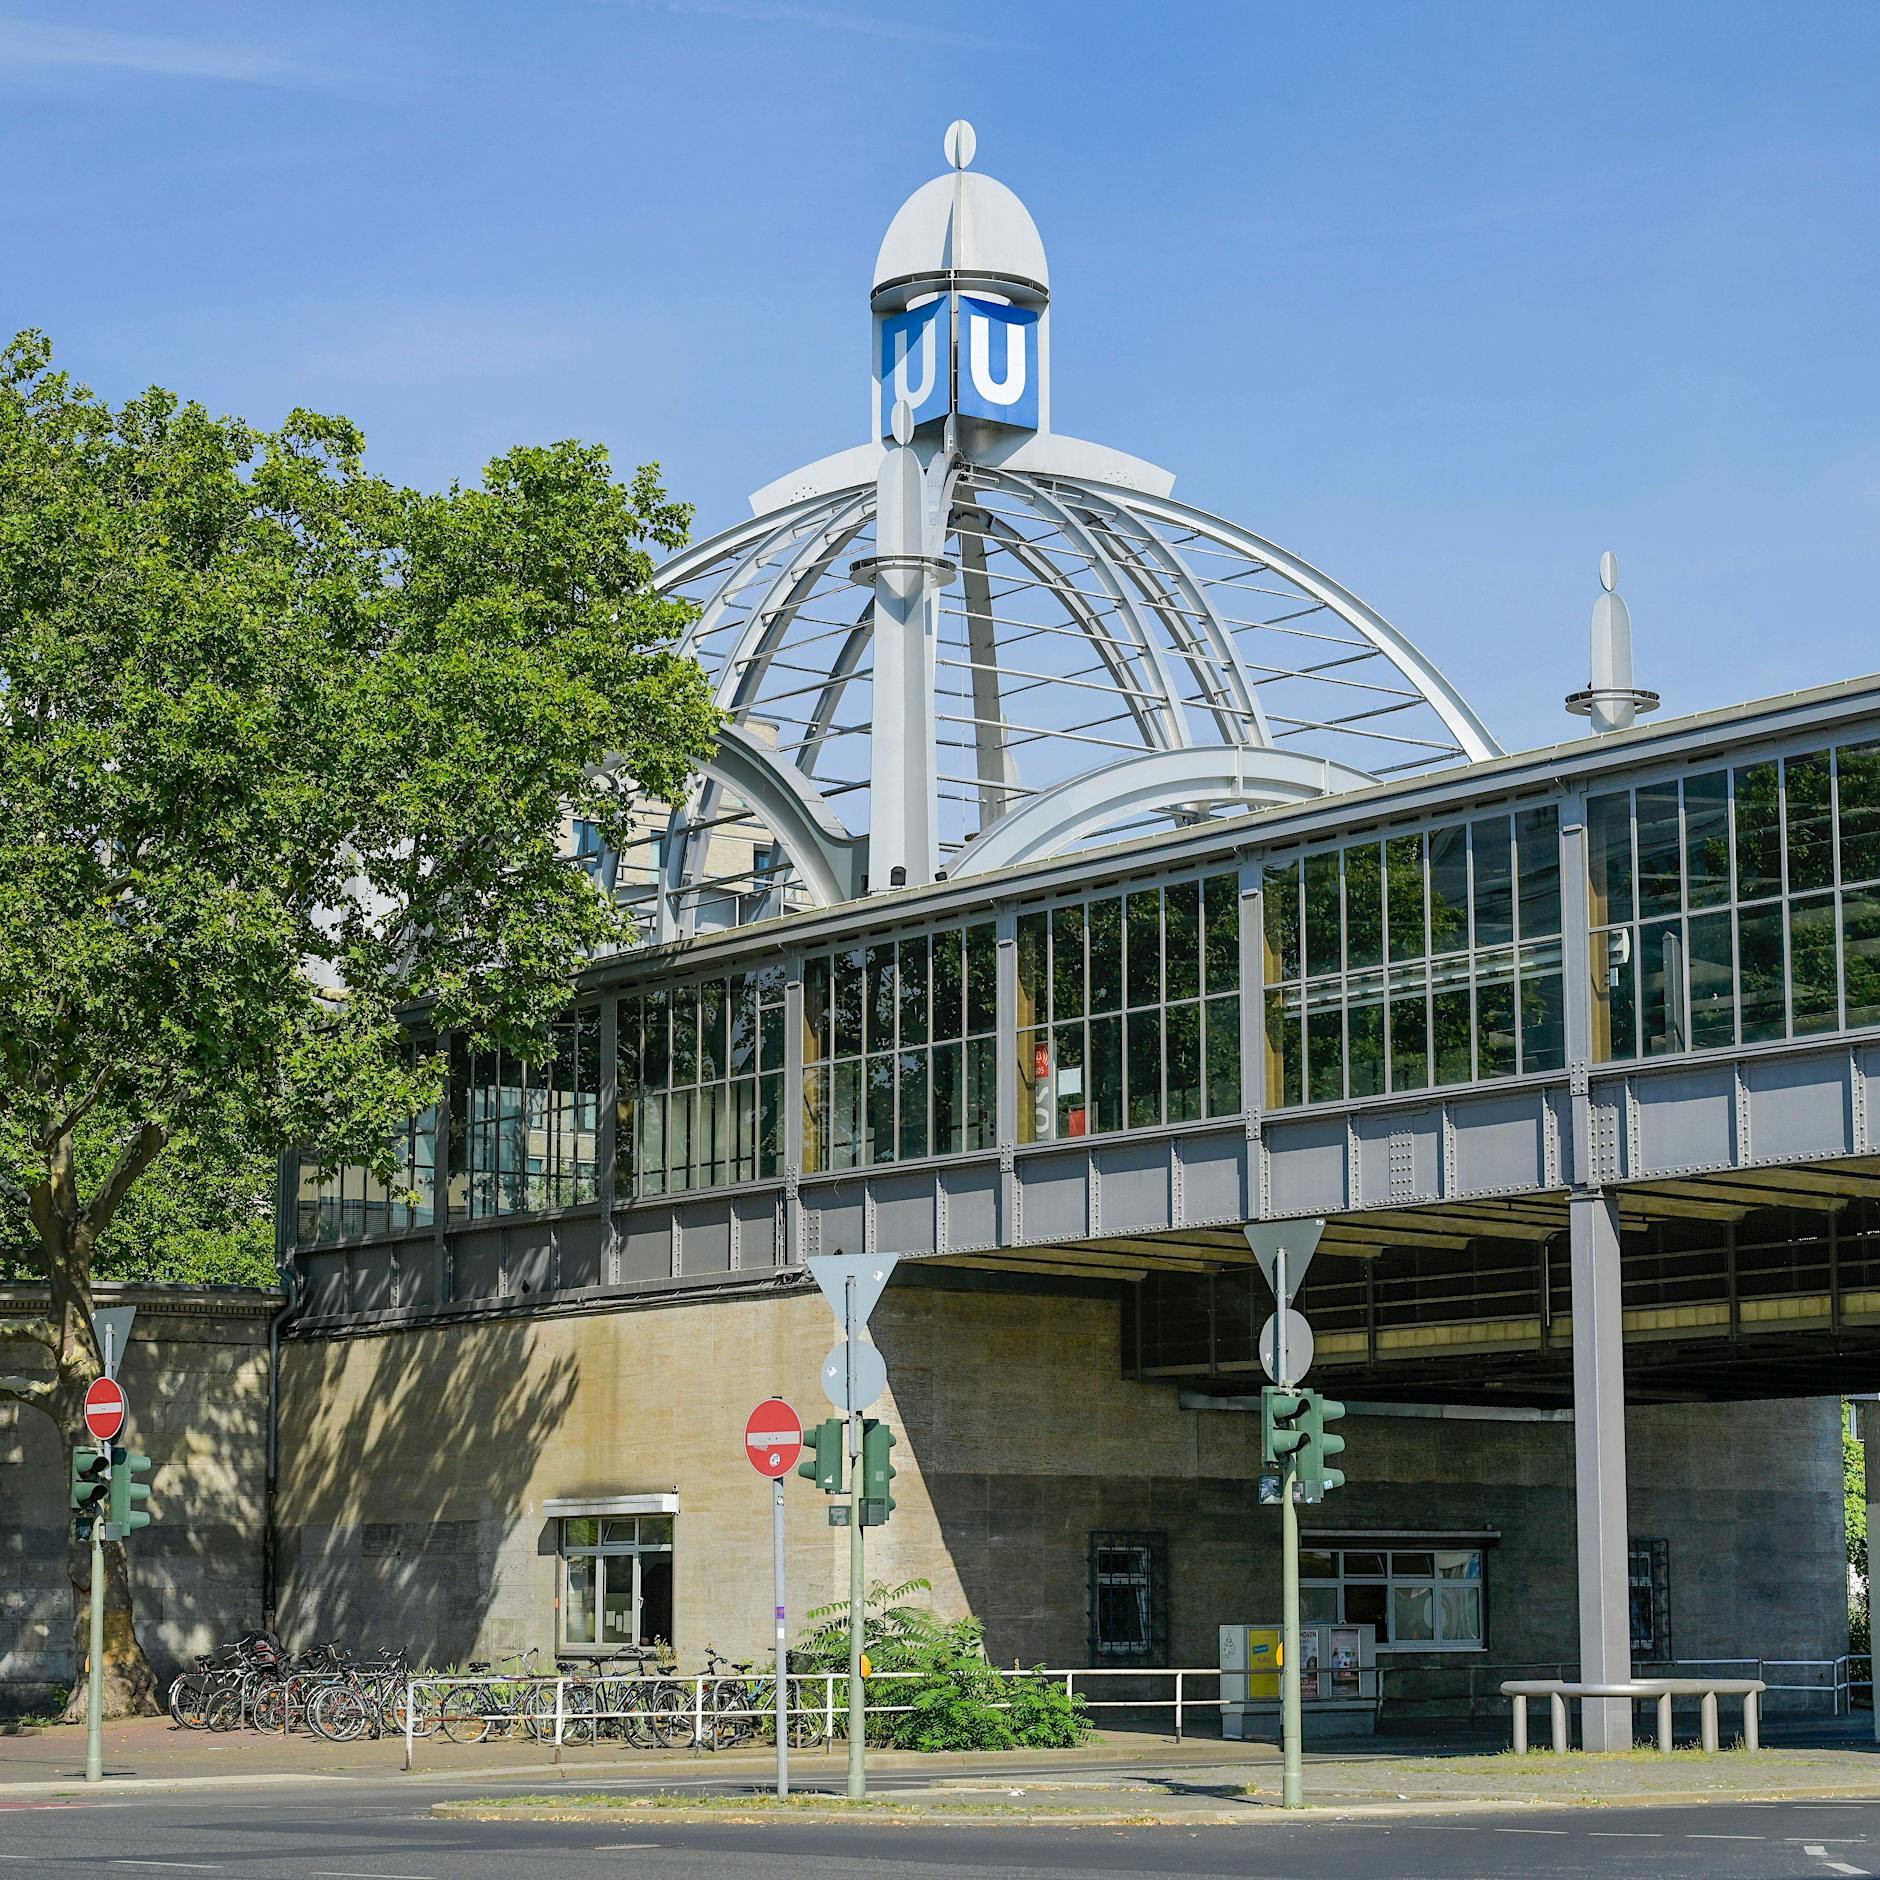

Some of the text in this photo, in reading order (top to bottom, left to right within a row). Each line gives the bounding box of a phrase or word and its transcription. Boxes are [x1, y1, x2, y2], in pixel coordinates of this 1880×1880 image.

[894, 317, 936, 410] U
[970, 314, 1026, 406] U
[1035, 1066, 1045, 1075] OS
